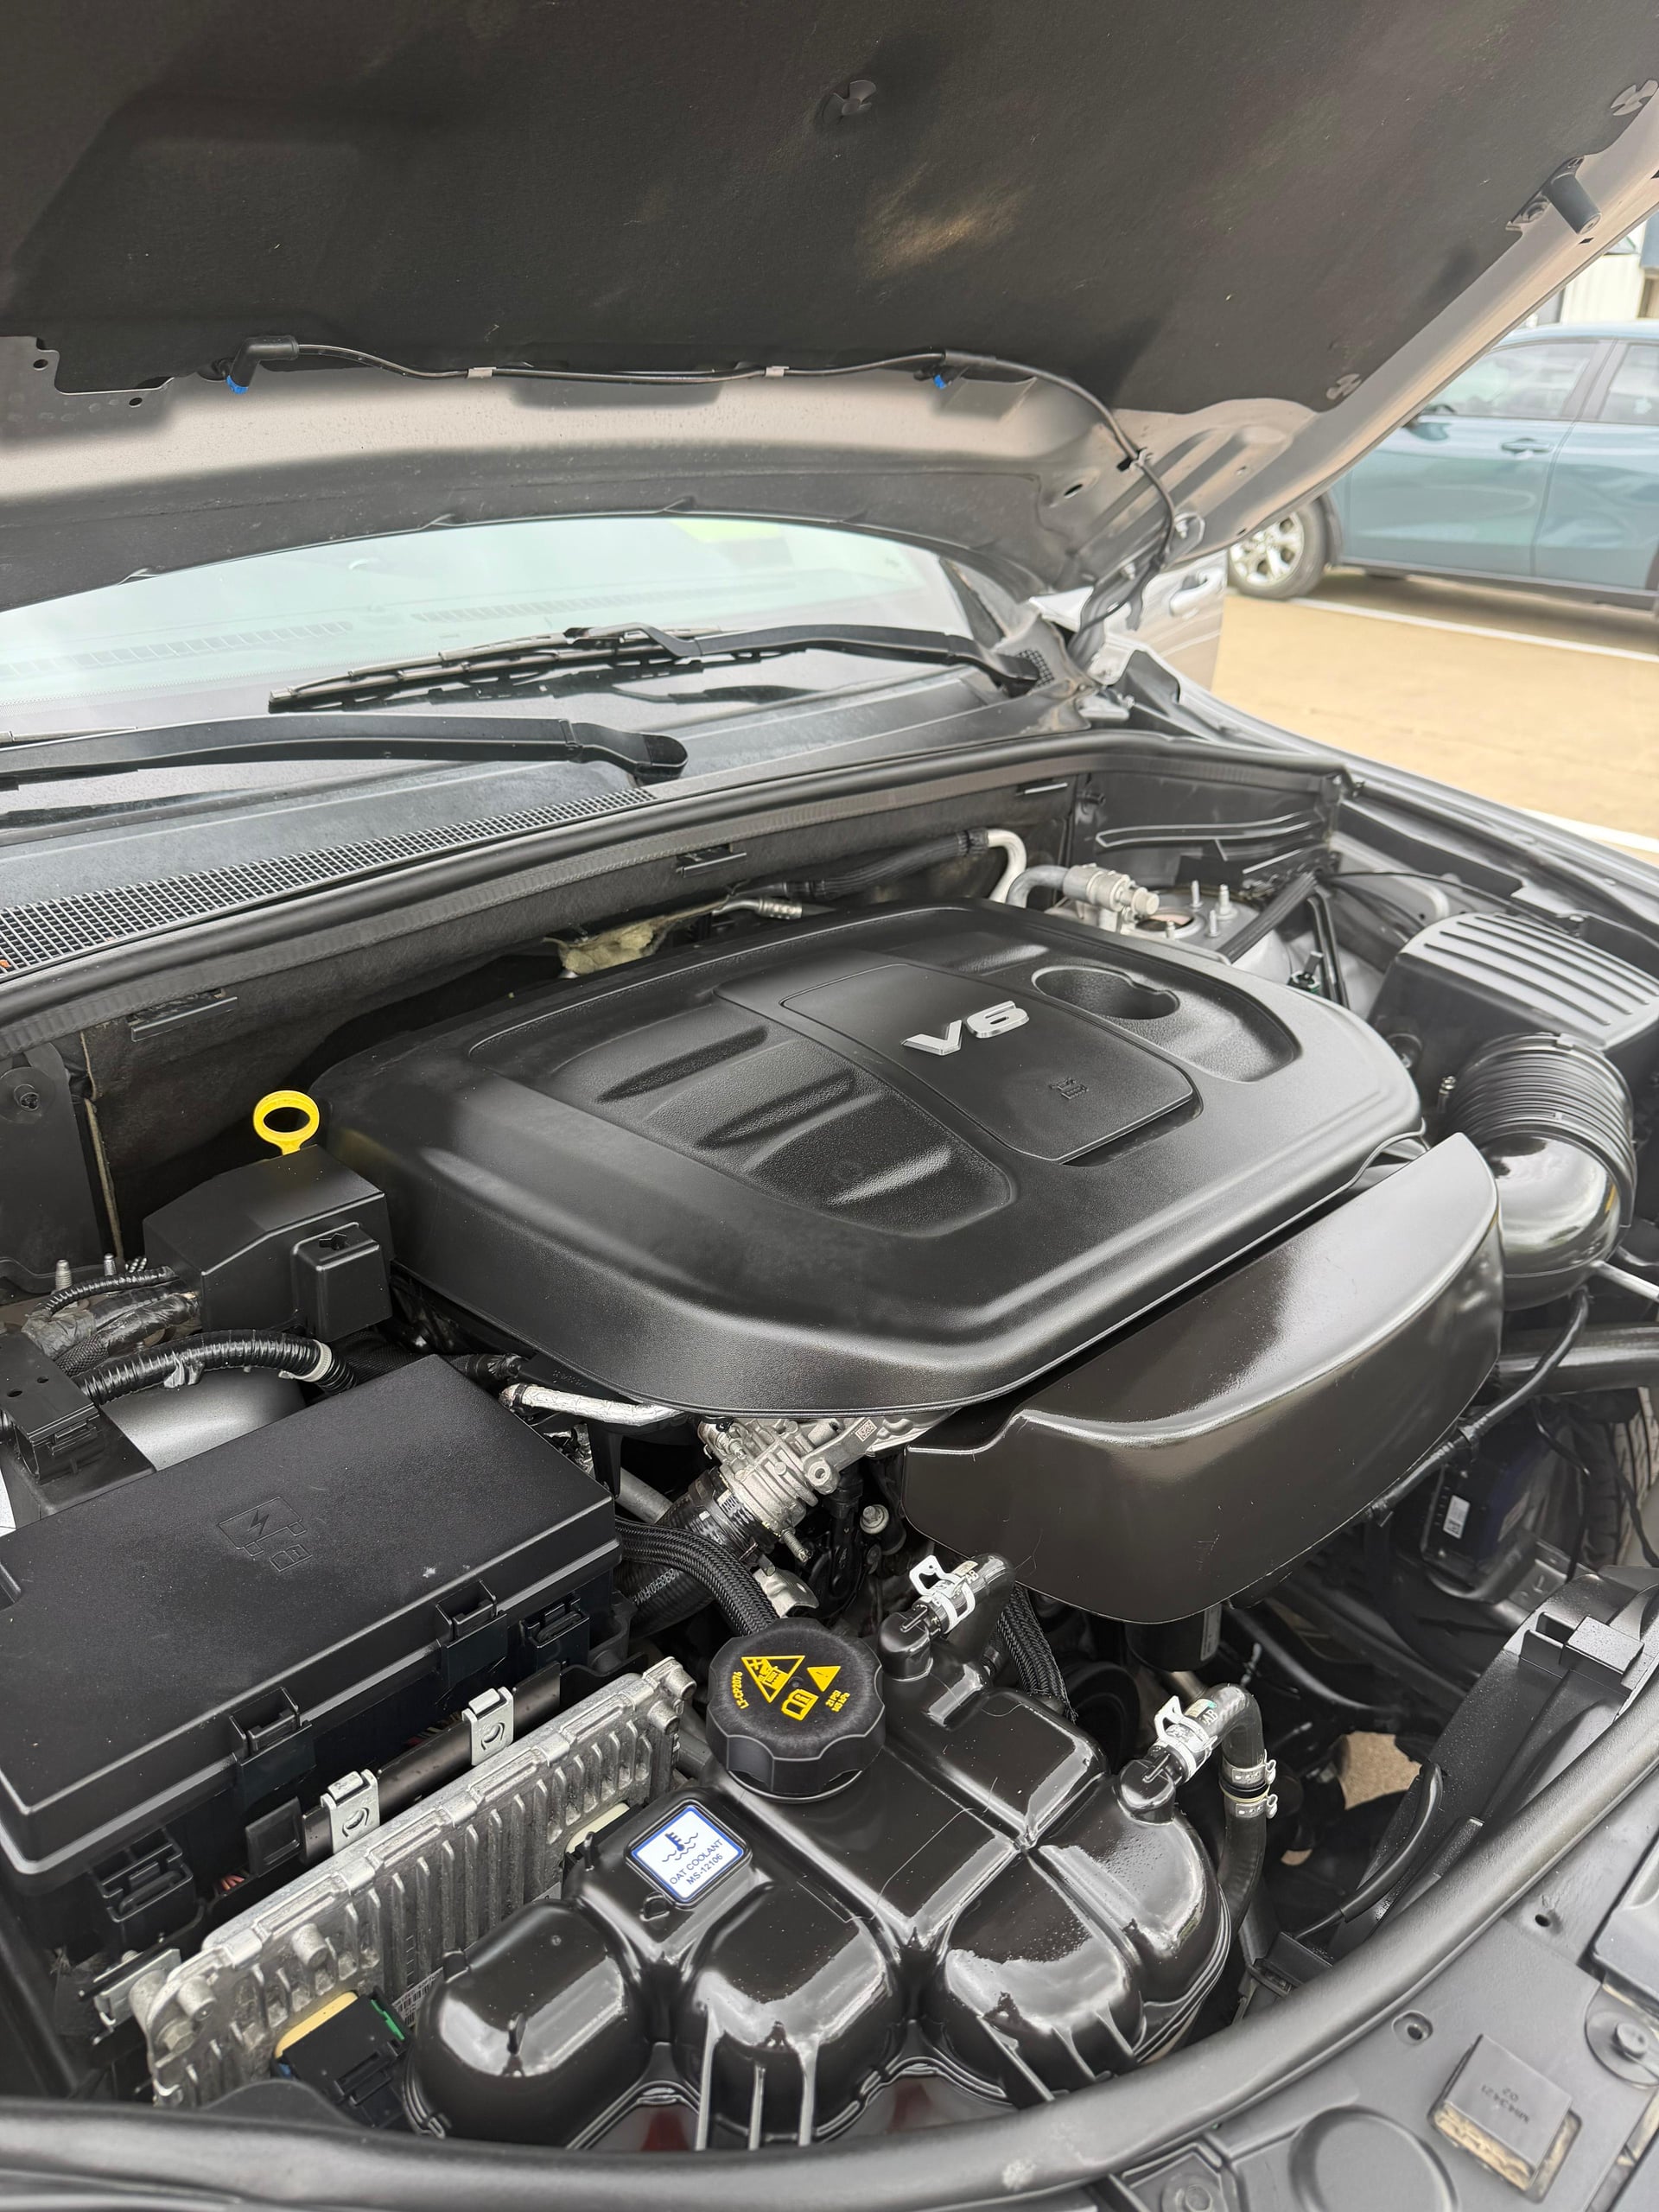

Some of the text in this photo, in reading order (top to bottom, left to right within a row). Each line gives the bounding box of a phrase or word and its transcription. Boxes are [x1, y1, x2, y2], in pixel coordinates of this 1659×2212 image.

[900, 1000, 1030, 1057] V6
[670, 1839, 723, 1885] OAT COOLANT
[686, 1853, 723, 1885] MS-12106
